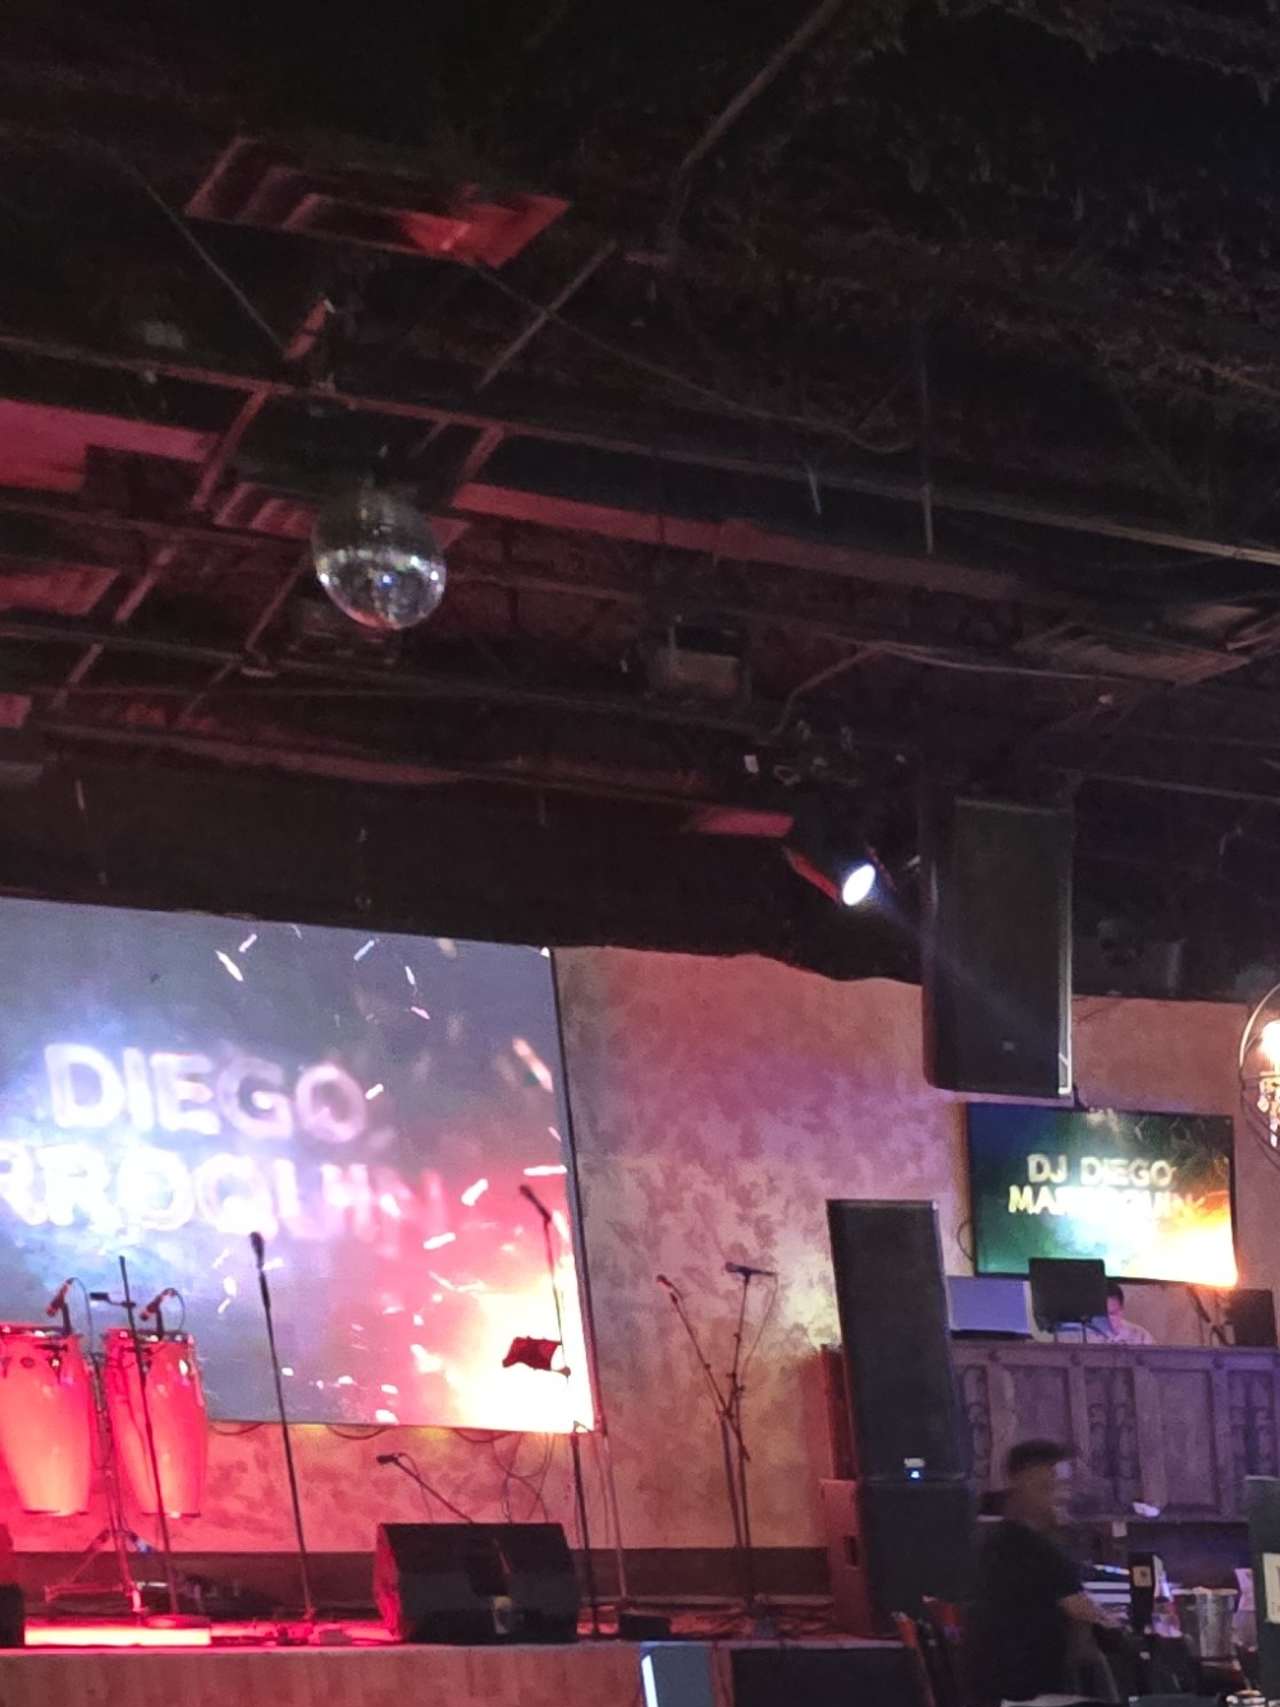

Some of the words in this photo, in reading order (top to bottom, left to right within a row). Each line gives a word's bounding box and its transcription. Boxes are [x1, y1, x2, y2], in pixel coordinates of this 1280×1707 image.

[43, 1043, 367, 1145] DIEGO
[1027, 1153, 1067, 1183] DJ
[1080, 1156, 1173, 1188] DIEGO
